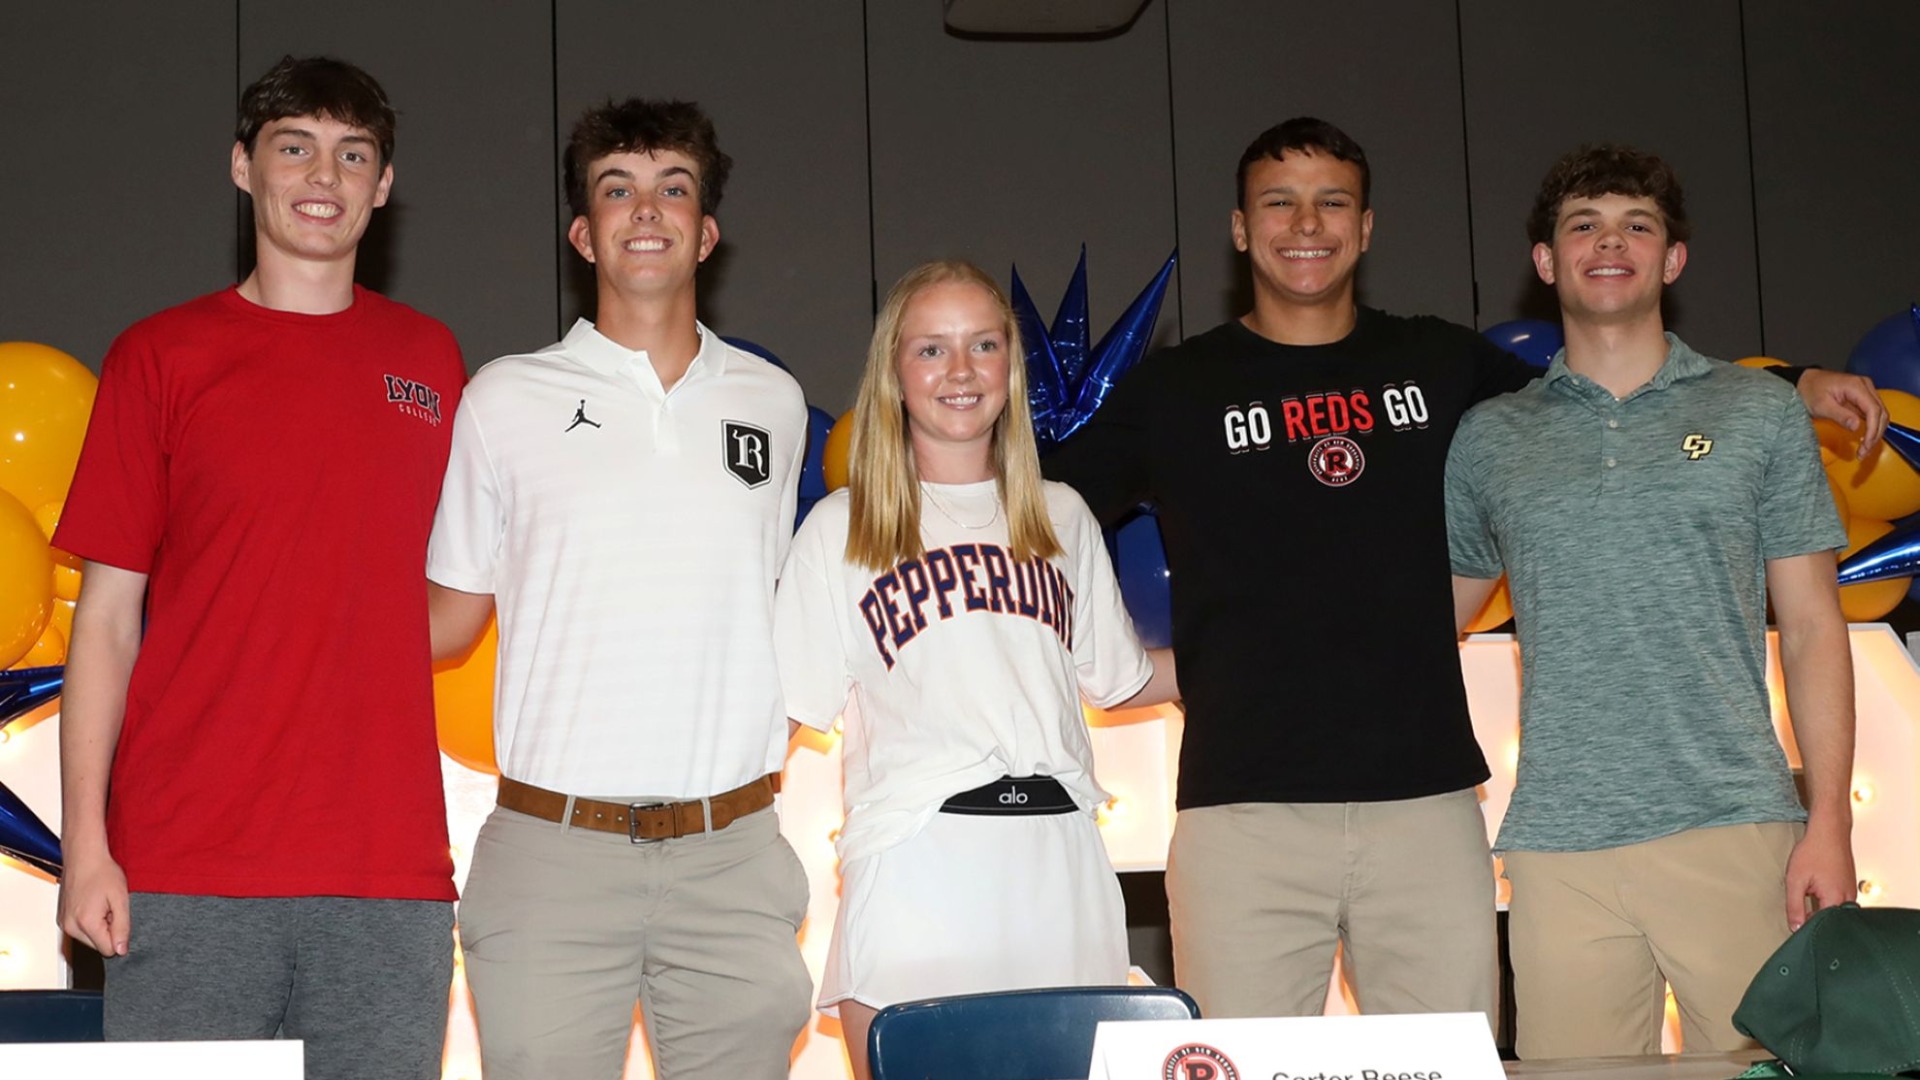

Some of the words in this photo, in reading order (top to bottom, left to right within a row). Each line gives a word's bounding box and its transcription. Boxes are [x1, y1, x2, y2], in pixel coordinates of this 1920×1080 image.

[384, 374, 441, 420] LYON
[1224, 406, 1272, 450] GO
[1282, 393, 1375, 441] REDS
[1383, 385, 1429, 428] GO
[998, 785, 1028, 804] alo
